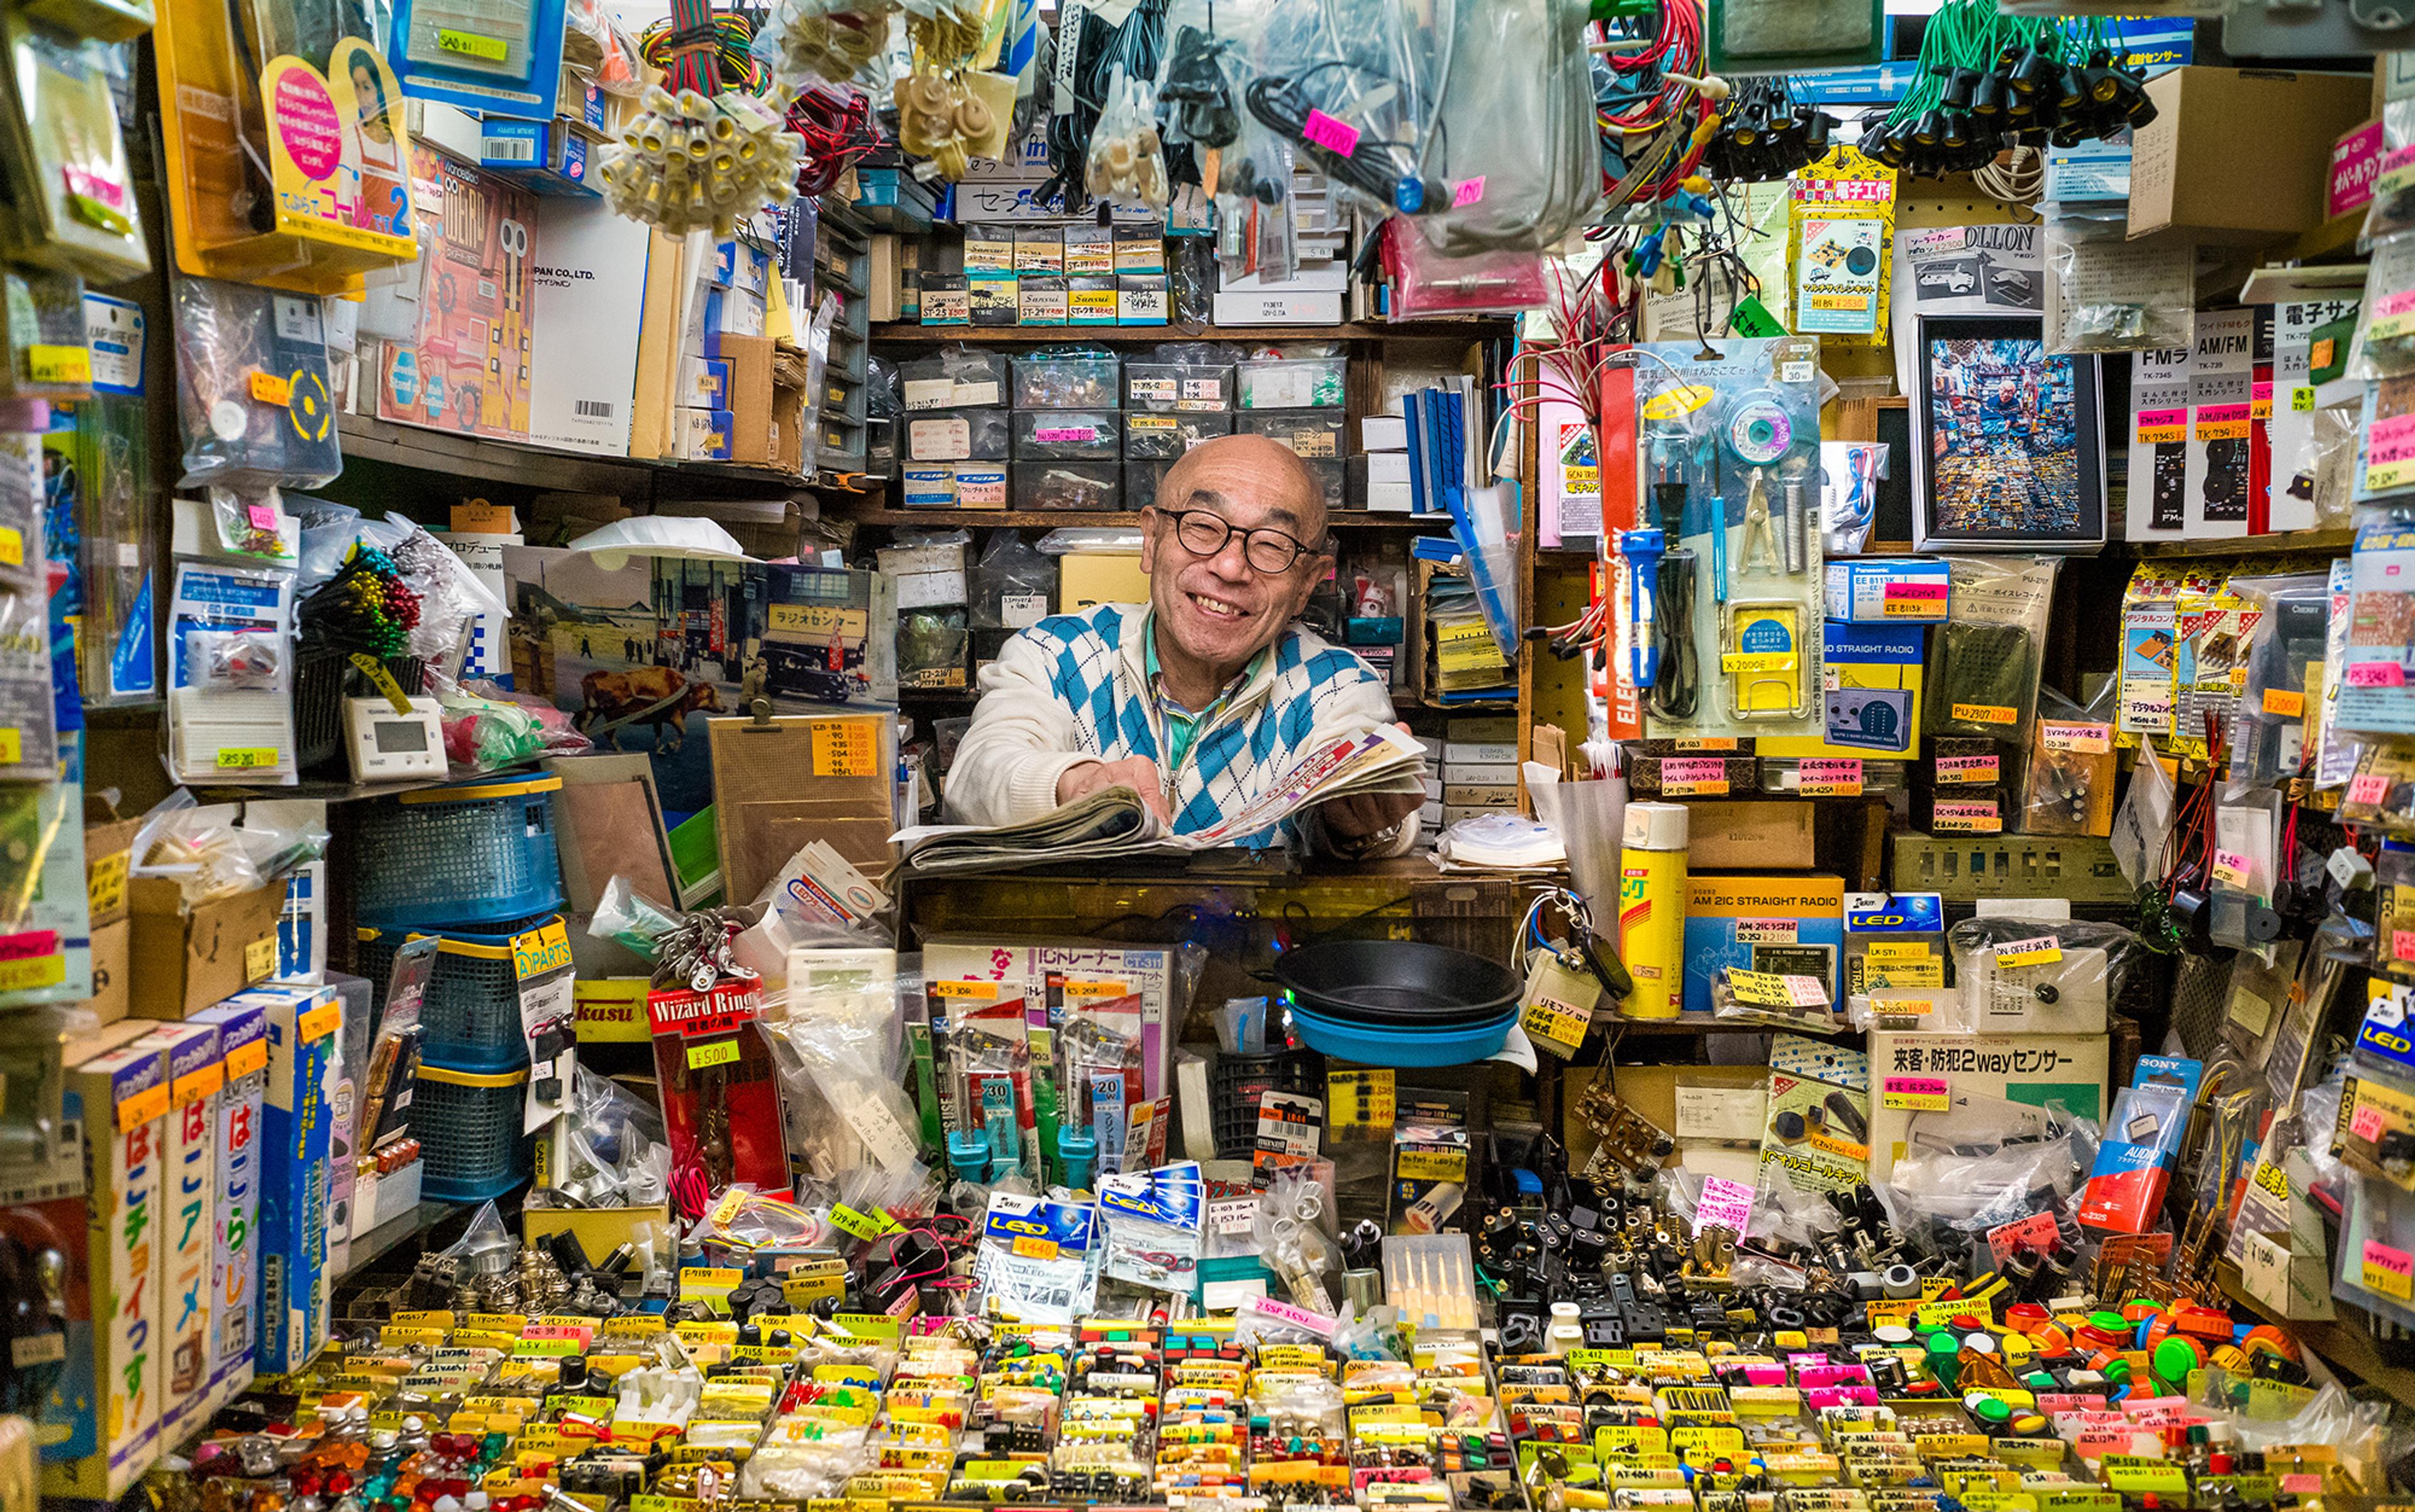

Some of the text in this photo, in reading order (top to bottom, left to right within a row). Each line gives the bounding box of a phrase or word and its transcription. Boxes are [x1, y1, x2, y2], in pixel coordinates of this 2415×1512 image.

[1836, 181, 1890, 200] 電子工作
[971, 245, 1004, 253] Sansui
[1935, 240, 1963, 250] ¥2300
[1802, 284, 1875, 294] マルチサイレンキット
[928, 294, 963, 304] Sansui
[1025, 295, 1060, 303] Sansui
[1074, 295, 1109, 303] Sansui
[1836, 298, 1863, 308] ¥2530
[923, 307, 946, 317] ST-25
[1022, 308, 1045, 316] ST-29
[2198, 335, 2247, 355] AM/FM
[1789, 372, 1801, 381] 30
[2197, 411, 2230, 422] AM/FM
[2139, 432, 2175, 442] TK-734S
[776, 611, 858, 626] ラジオセンター
[1836, 645, 1914, 654] STRAIGHT RADIO
[2267, 696, 2299, 712] ¥2000
[1954, 706, 2015, 721] PU-2307 ¥2200
[1692, 896, 1711, 906] AM
[1737, 896, 1797, 906] STRAIGHT
[1800, 897, 1838, 906] RADIO
[1852, 914, 1904, 926] LED
[1762, 932, 1792, 942] ¥2100
[533, 942, 571, 970] PARTS
[1038, 947, 1121, 965] ICトレーナー
[1124, 957, 1162, 969] CT-311
[653, 991, 753, 1023] Wizard Ring
[1540, 998, 1574, 1015] リモコン
[1907, 1002, 1931, 1014] ¥600
[686, 1017, 733, 1032] 賢者の輪
[1555, 1016, 1584, 1032] ¥2480
[1550, 1030, 1580, 1044] ¥3980
[2365, 1027, 2411, 1053] LED
[694, 1048, 728, 1063] ¥500
[1894, 1048, 2072, 1074] 来客・防犯2wayセンサー
[2140, 1058, 2180, 1070] SONY
[987, 1084, 1007, 1098] 30
[1098, 1081, 1116, 1094] 20
[995, 1097, 1006, 1105] W
[1286, 1113, 1307, 1124] LR44
[1257, 1137, 1285, 1149] maxell
[2124, 1147, 2160, 1162] AUDIO
[1761, 1149, 1865, 1186] ICオルゴールキット
[1104, 1193, 1158, 1215] LED
[989, 1216, 1048, 1235] LED
[1019, 1240, 1052, 1257] ¥440
[1572, 1351, 1603, 1359] DS-412
